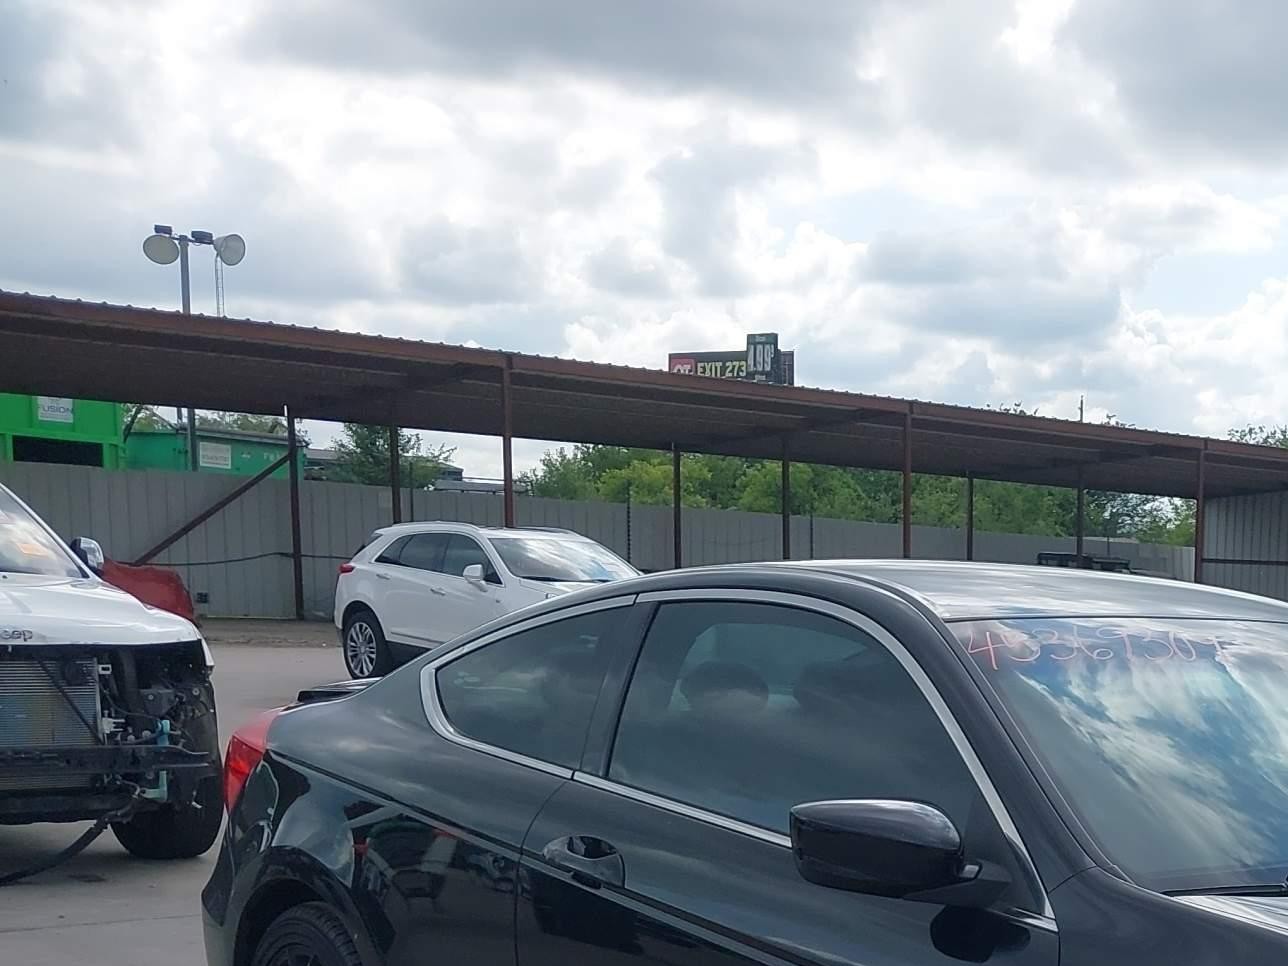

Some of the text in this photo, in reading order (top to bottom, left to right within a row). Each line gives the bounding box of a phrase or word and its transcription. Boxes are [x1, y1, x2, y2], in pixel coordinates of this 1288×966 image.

[697, 361, 746, 378] EXIT 273
[0, 629, 33, 642] eep
